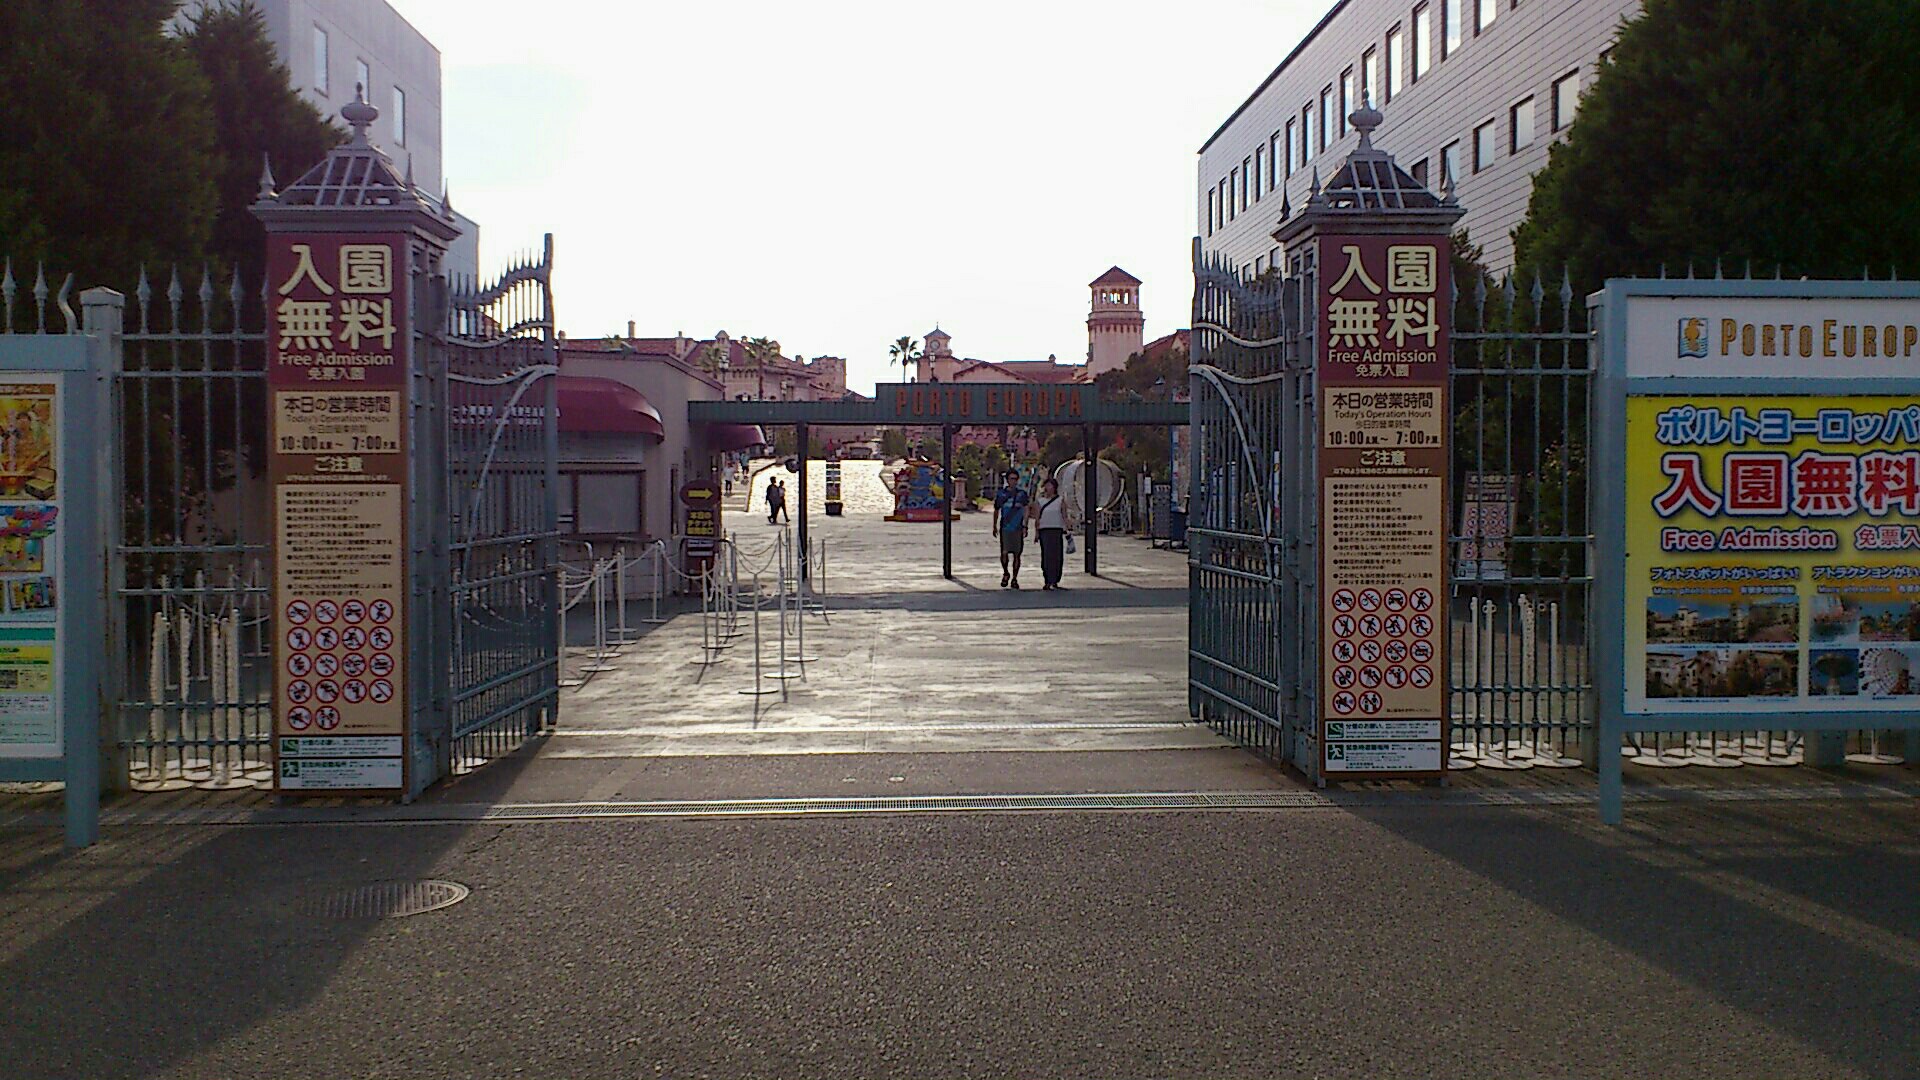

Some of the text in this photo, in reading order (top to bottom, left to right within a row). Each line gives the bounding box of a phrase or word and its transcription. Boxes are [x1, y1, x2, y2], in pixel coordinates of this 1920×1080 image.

[279, 245, 393, 295] 入園
[1328, 246, 1437, 295] 入園
[278, 299, 397, 349] 無料
[1328, 298, 1440, 348] 無料
[1720, 318, 1813, 358] PORTO
[279, 352, 394, 366] Free Admission
[1328, 349, 1437, 363] Free Admission
[284, 396, 391, 413] 本日の営業時間
[896, 388, 1082, 417] PORTO EUROPA
[1332, 392, 1434, 409] 本日の営業時間
[1335, 410, 1365, 419] Today's
[1366, 410, 1407, 419] Operation
[1658, 406, 1920, 444] ポルトヨーロッパ
[1360, 450, 1406, 466] ご注意
[1655, 454, 1920, 516] 入園無料
[1664, 530, 1837, 548] Free Admission
